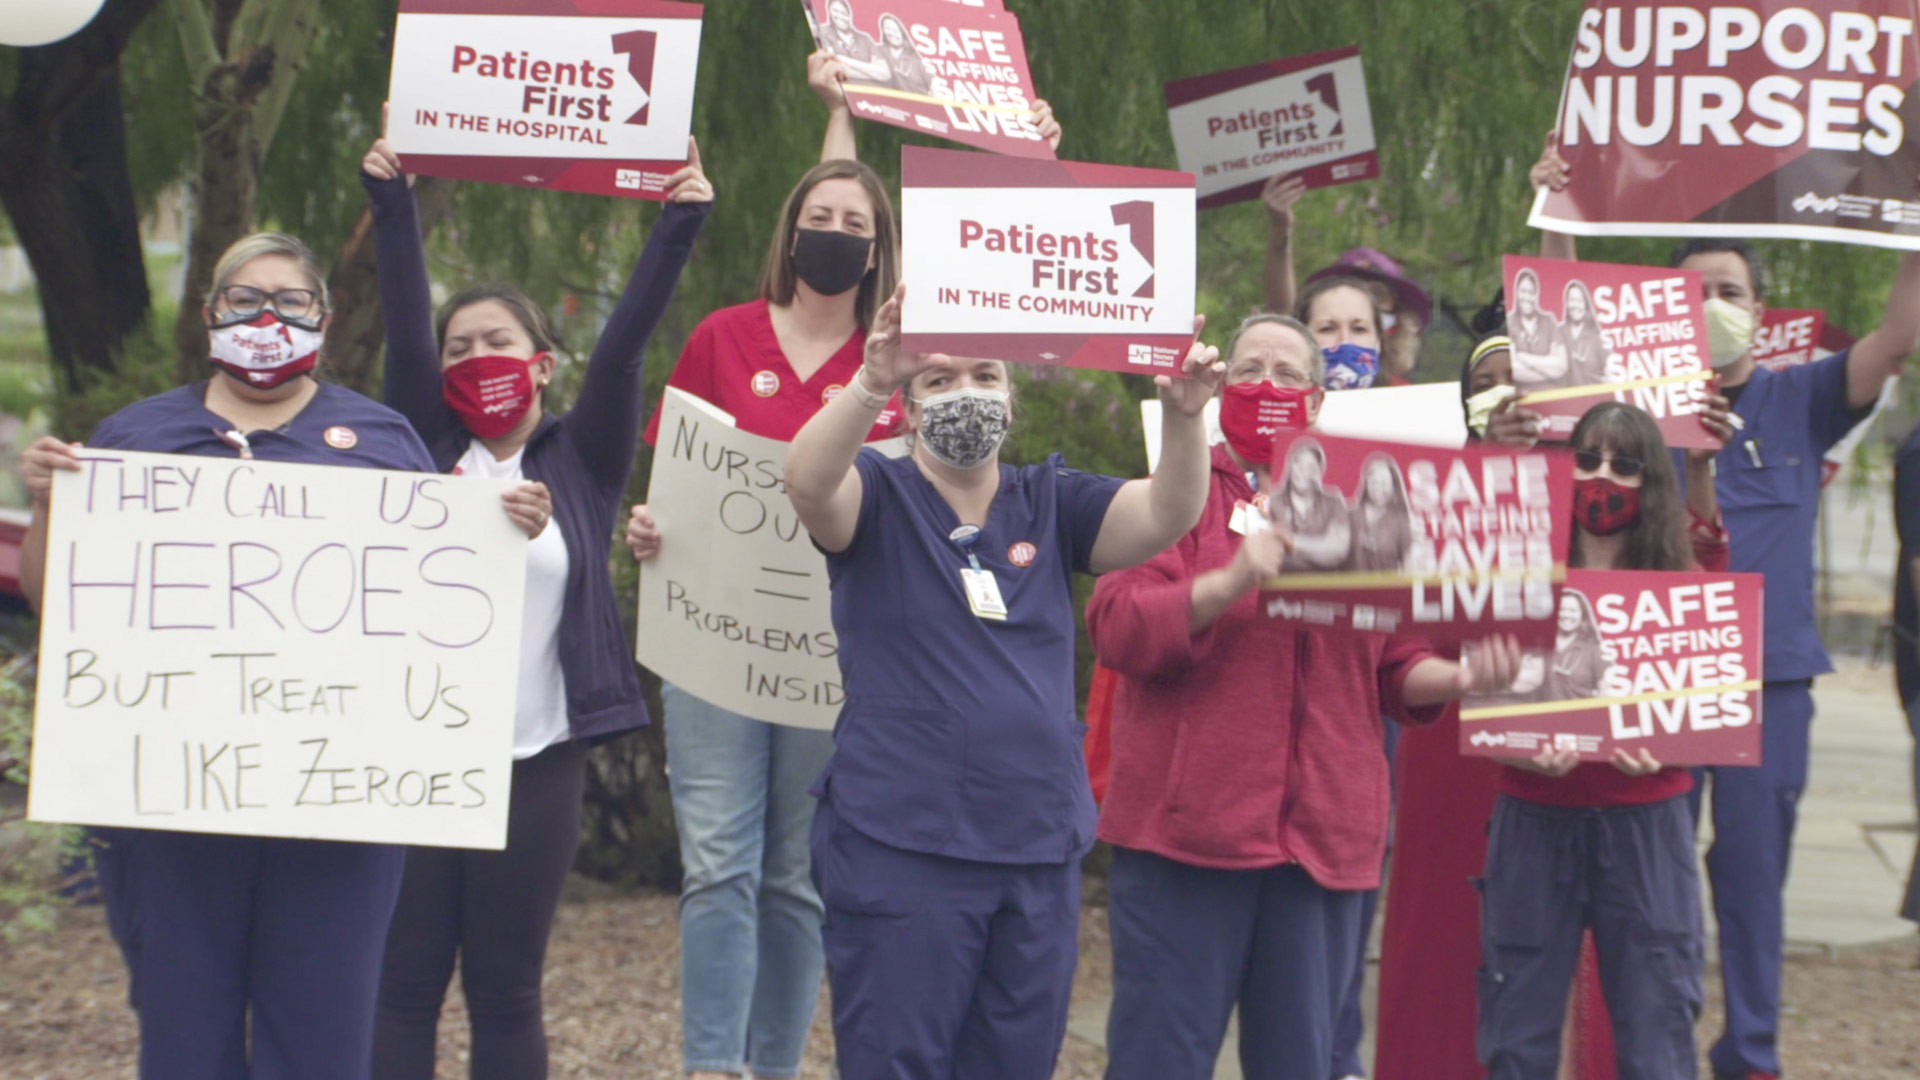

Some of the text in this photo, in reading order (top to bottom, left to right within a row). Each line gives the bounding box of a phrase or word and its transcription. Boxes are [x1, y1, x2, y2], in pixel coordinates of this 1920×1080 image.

[910, 24, 1012, 63] SAFE
[1573, 7, 1913, 77] SUPPORT
[452, 45, 615, 89] Patients
[921, 57, 1019, 84] STAFFING
[522, 85, 612, 122] First
[929, 77, 1030, 110] SAVES
[415, 109, 608, 145] IN THE HOSPITAL
[942, 102, 1043, 141] LIVES
[1207, 102, 1316, 138] Patients
[1257, 121, 1318, 149] First
[1563, 75, 1905, 156] NURSES
[1202, 140, 1346, 177] IN THE COMMUNITY
[959, 219, 1119, 262] Patients
[1032, 259, 1119, 296] First
[938, 287, 1154, 322] IN THE COMMUNITY
[1594, 277, 1690, 324] SAFE
[1602, 319, 1695, 350] STAFFING
[1752, 316, 1815, 357] SAFE
[1606, 344, 1703, 384] SAVES
[1614, 378, 1711, 420] LIVES
[76, 457, 449, 529] THEY CALL US
[1408, 453, 1550, 512] SAFE
[1405, 534, 1553, 580] SAVES
[67, 540, 494, 648] HEROES
[1412, 574, 1555, 622] LIVES
[1597, 581, 1739, 633] SAFE
[1600, 625, 1742, 662] STAFFING
[63, 649, 470, 728] BUT TREAT US
[1605, 652, 1747, 697] SAVES
[1609, 690, 1752, 739] LIVES
[134, 734, 486, 816] LIKE ZEROES
